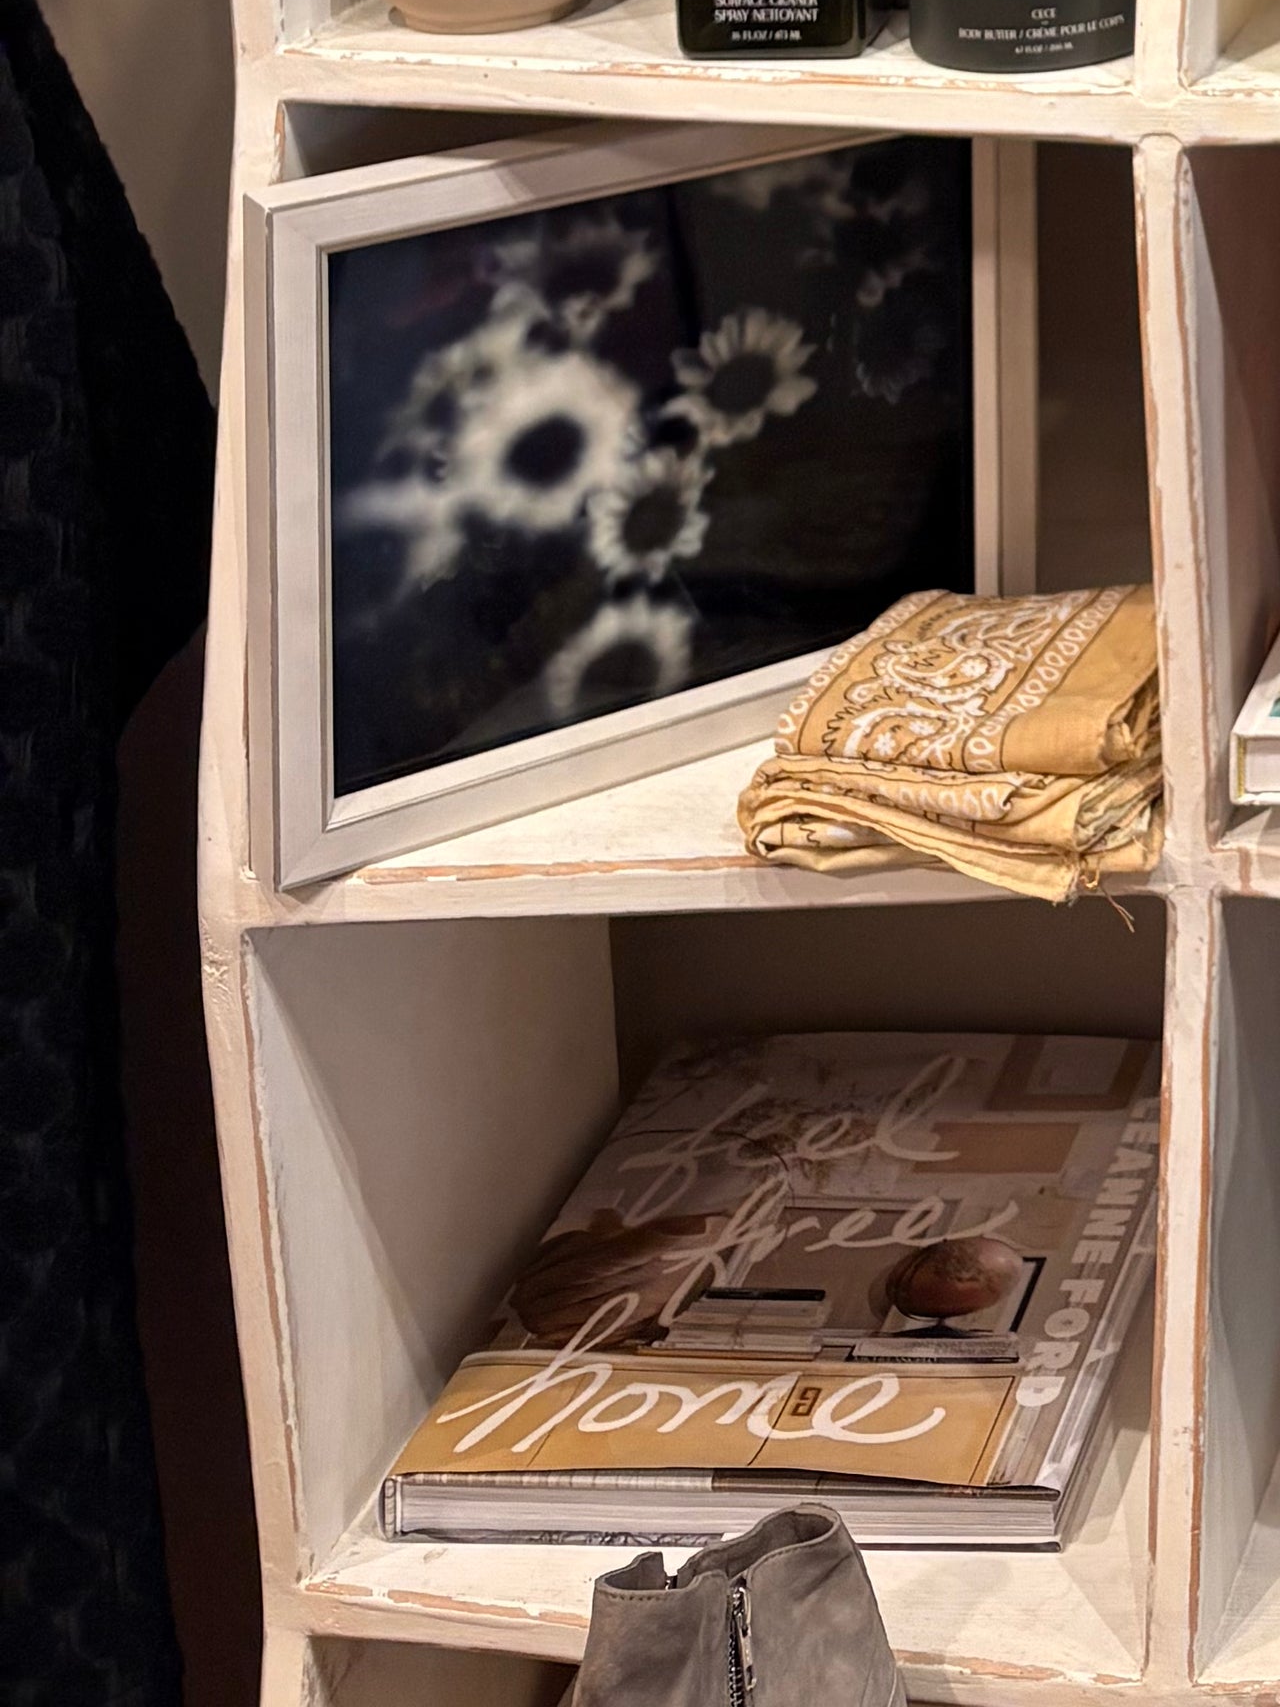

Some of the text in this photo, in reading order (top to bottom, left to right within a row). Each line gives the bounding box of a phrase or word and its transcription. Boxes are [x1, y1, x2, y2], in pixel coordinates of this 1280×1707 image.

[1060, 23, 1086, 36] POUR
[1087, 20, 1098, 32] LE
[618, 1053, 967, 1225] feel
[656, 1179, 1020, 1329] free
[1013, 1096, 1162, 1408] LEANNE FORD
[436, 1292, 947, 1457] home
